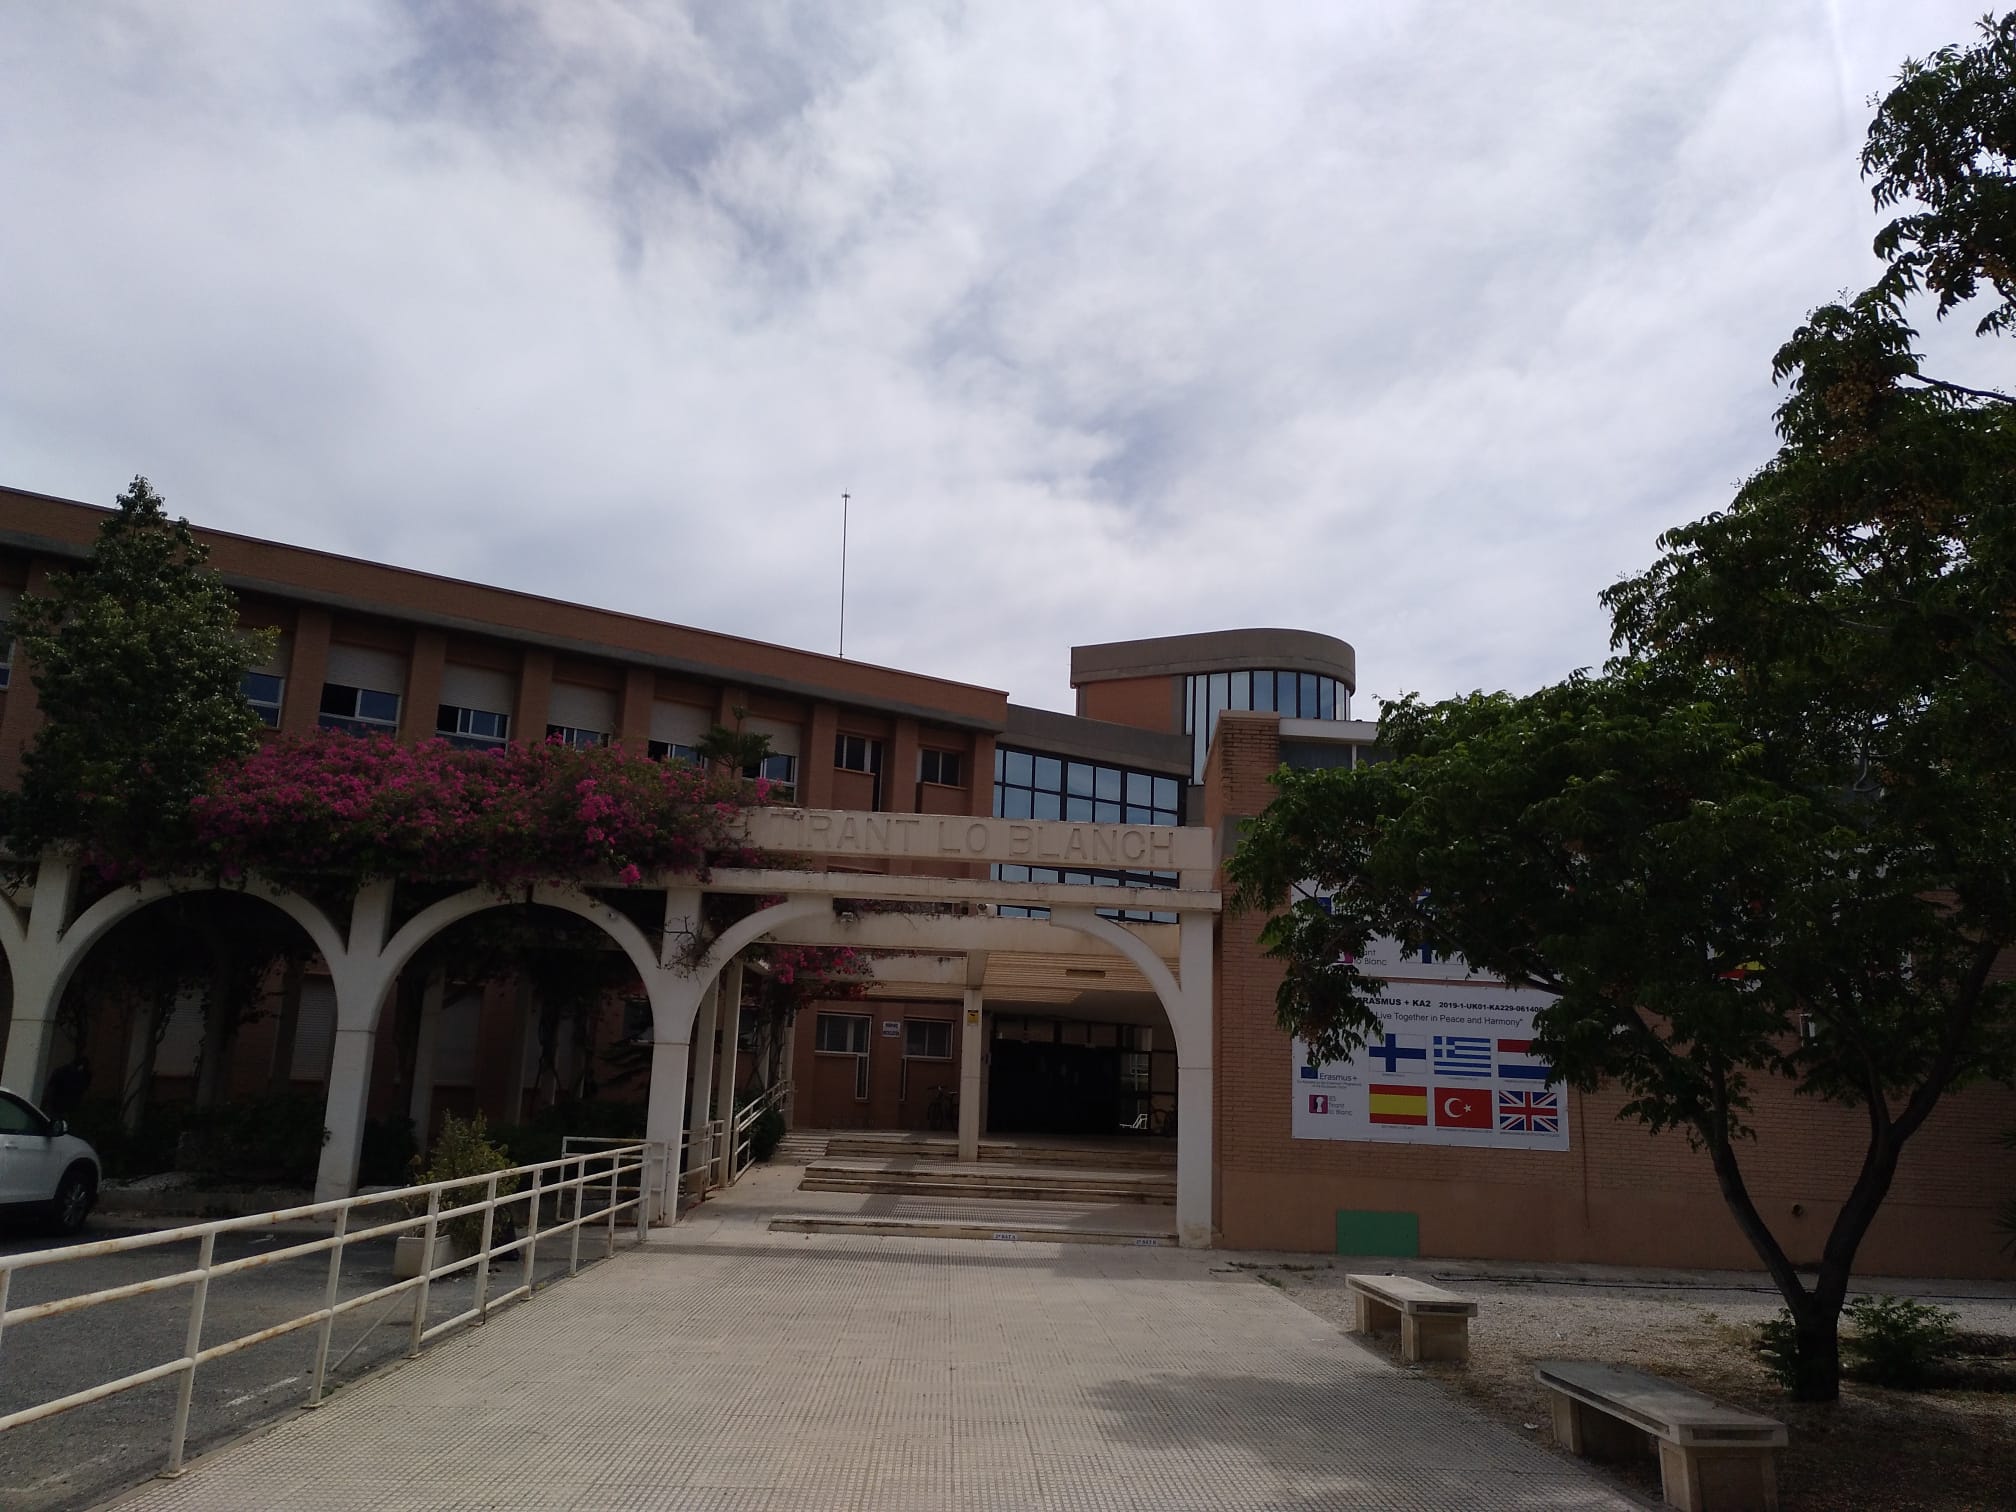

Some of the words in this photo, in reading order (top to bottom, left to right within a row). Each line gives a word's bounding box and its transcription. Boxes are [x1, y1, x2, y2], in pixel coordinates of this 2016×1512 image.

[770, 811, 920, 852] TIRANT
[939, 820, 990, 853] LO
[1008, 824, 1174, 864] BLANCH
[1364, 957, 1387, 966] Blanc
[1412, 999, 1431, 1008] KA2
[1394, 1012, 1428, 1023] Together
[1430, 1014, 1438, 1022] in
[1439, 1014, 1465, 1024] Peace
[1467, 1016, 1482, 1025] and
